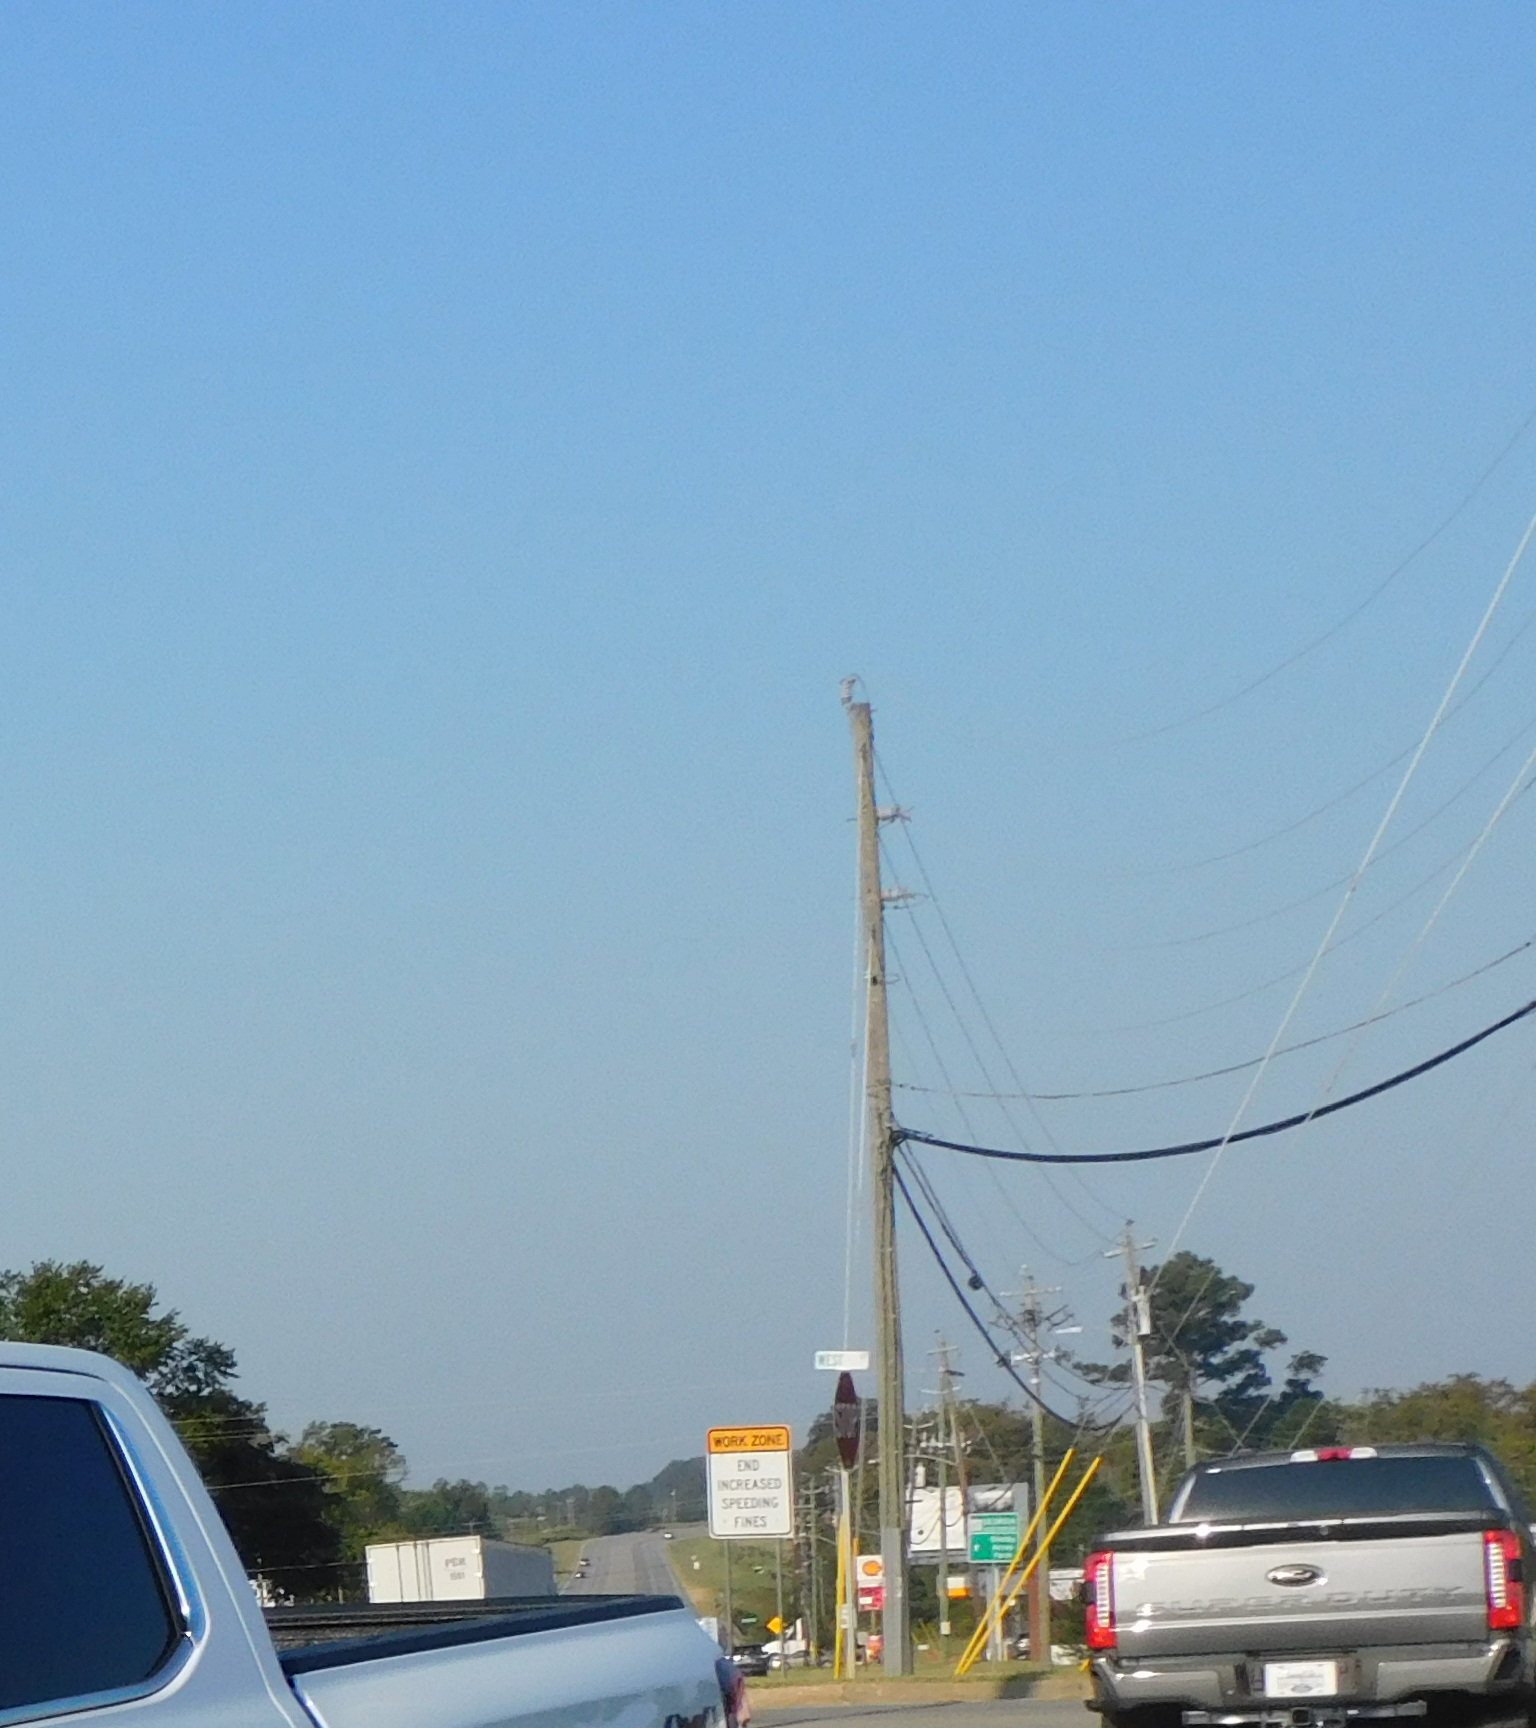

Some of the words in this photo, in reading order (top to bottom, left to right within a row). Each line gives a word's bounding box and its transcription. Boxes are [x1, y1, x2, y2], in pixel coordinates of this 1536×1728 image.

[713, 1435, 748, 1448] WORK
[751, 1433, 784, 1446] ZONE
[737, 1459, 760, 1472] END
[717, 1478, 782, 1491] INCREASED
[721, 1497, 779, 1510] SPEEDING
[734, 1516, 768, 1528] FINES
